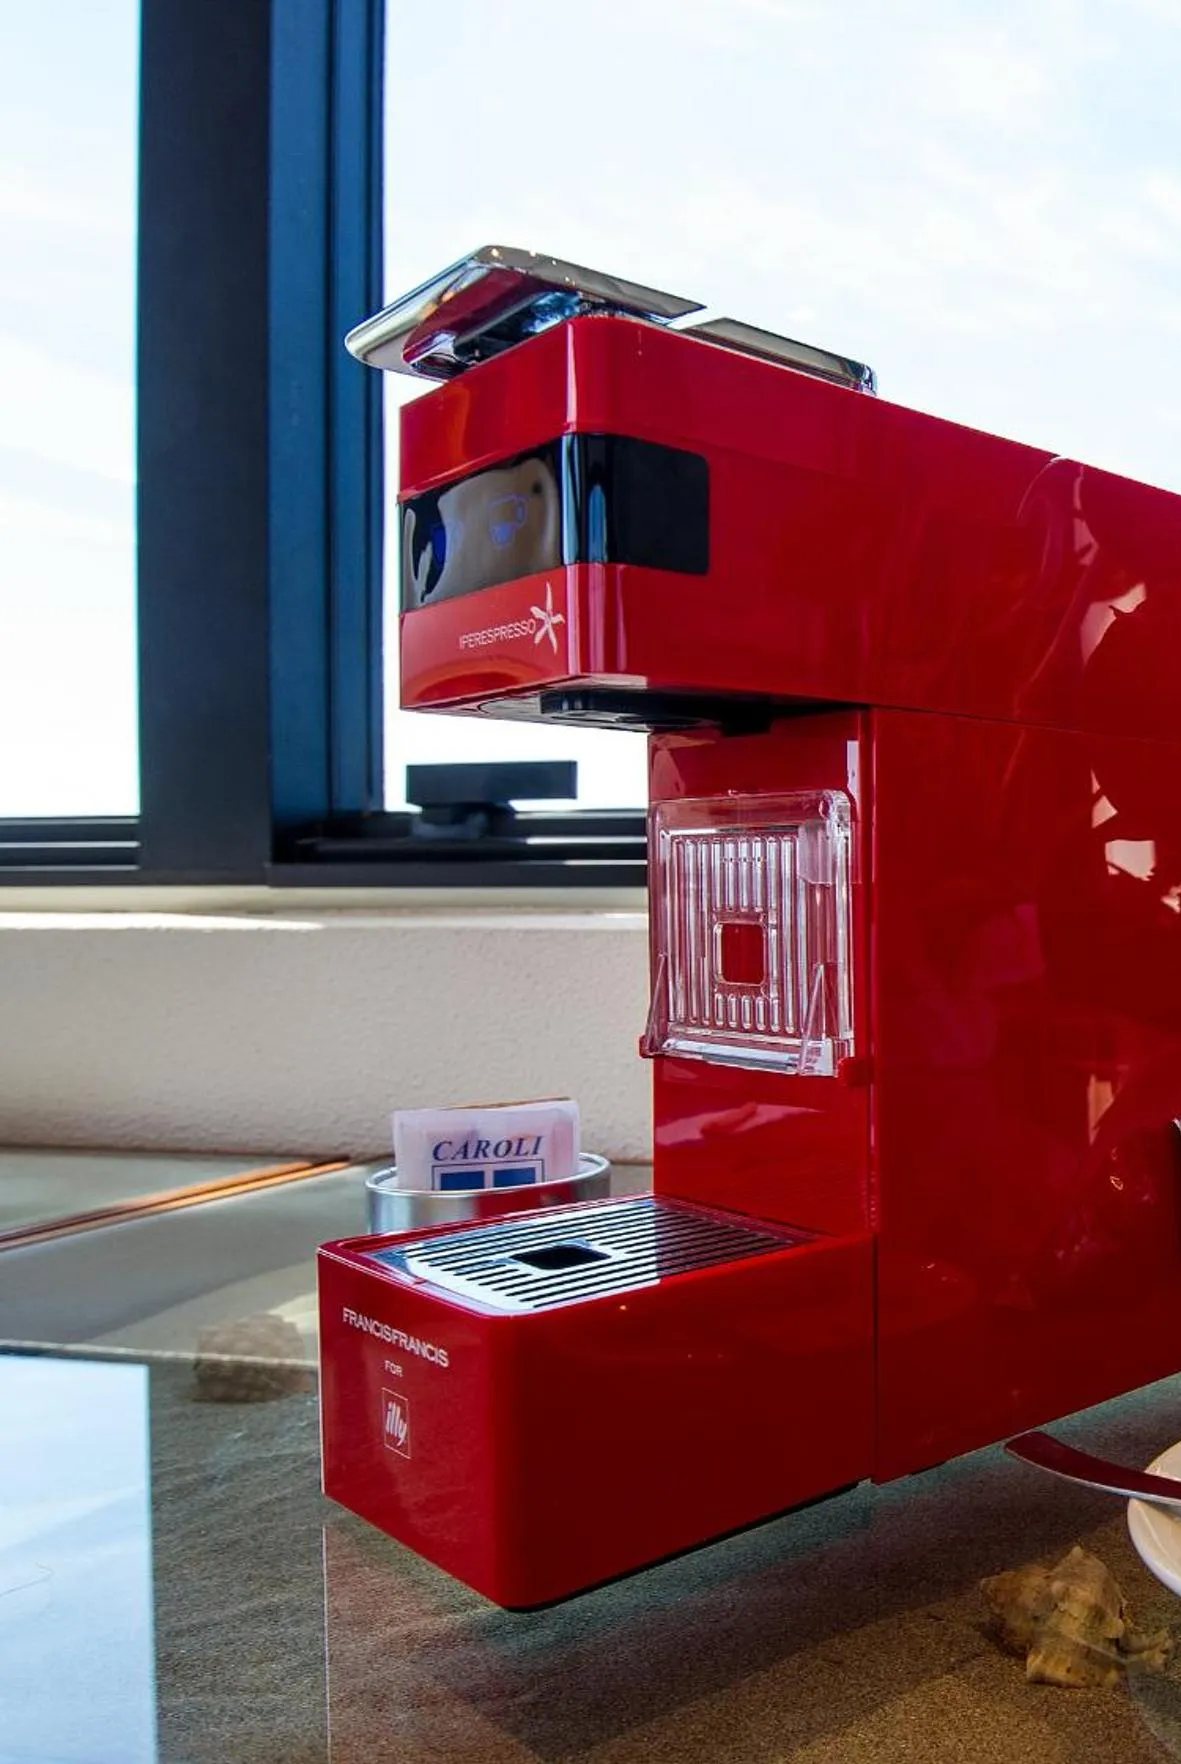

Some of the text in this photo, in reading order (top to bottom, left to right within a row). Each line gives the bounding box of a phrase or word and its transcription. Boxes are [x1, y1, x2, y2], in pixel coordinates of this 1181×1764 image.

[432, 1136, 543, 1161] CAROLI
[342, 1307, 449, 1367] FRANCISFRANCIS
[384, 1359, 403, 1377] FOR
[386, 1401, 408, 1446] illy
